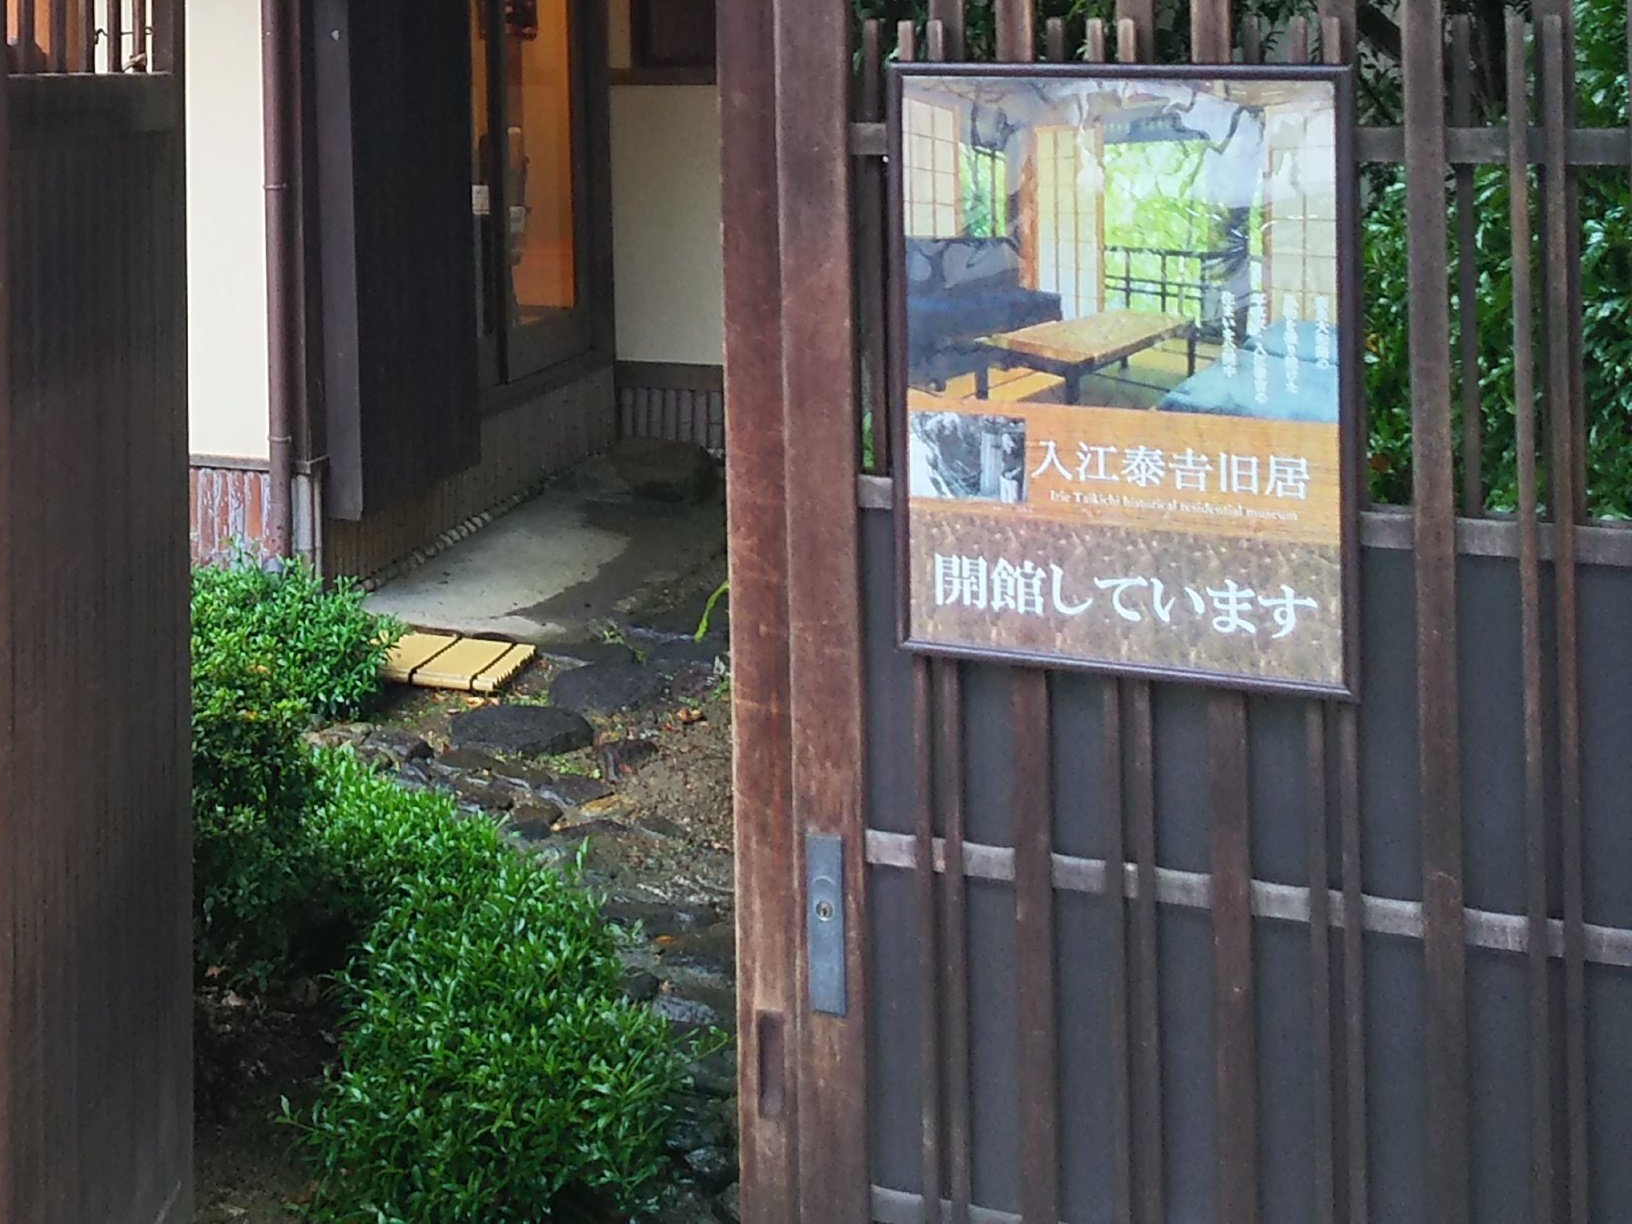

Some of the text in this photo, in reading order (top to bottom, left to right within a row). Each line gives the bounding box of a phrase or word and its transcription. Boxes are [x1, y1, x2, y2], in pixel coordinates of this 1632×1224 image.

[1246, 508, 1299, 521] museum
[934, 553, 1318, 640] 開館しています
